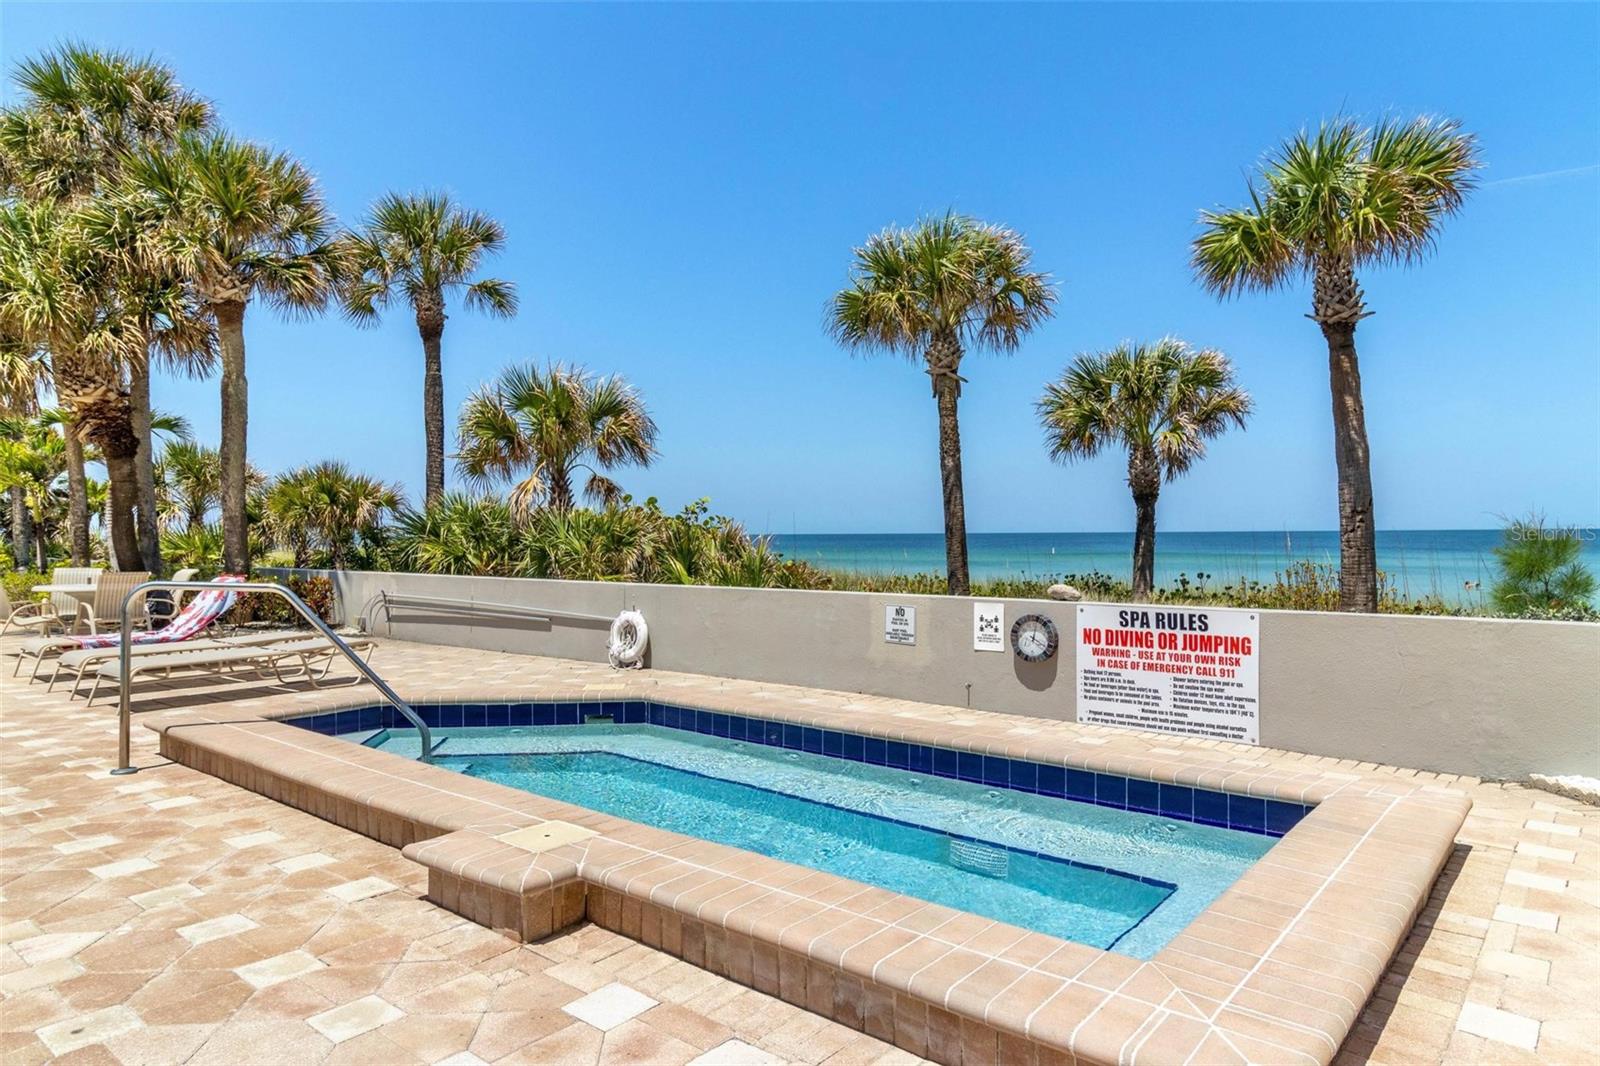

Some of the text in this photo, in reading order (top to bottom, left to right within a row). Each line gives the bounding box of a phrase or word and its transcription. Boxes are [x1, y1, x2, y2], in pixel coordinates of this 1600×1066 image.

[896, 608, 905, 616] NO
[1119, 610, 1208, 632] SPA RULES
[1083, 627, 1251, 656] NO DIVING OR JUMPING
[1091, 646, 1130, 658] WARNING
[1138, 650, 1154, 660] USE
[1156, 651, 1165, 661] AT
[1168, 652, 1191, 663] YOUR
[1194, 654, 1215, 665] OWN
[1218, 656, 1240, 667] RISK
[1097, 658, 1235, 678] IN CASE OF EMERGENCY CALL 911
